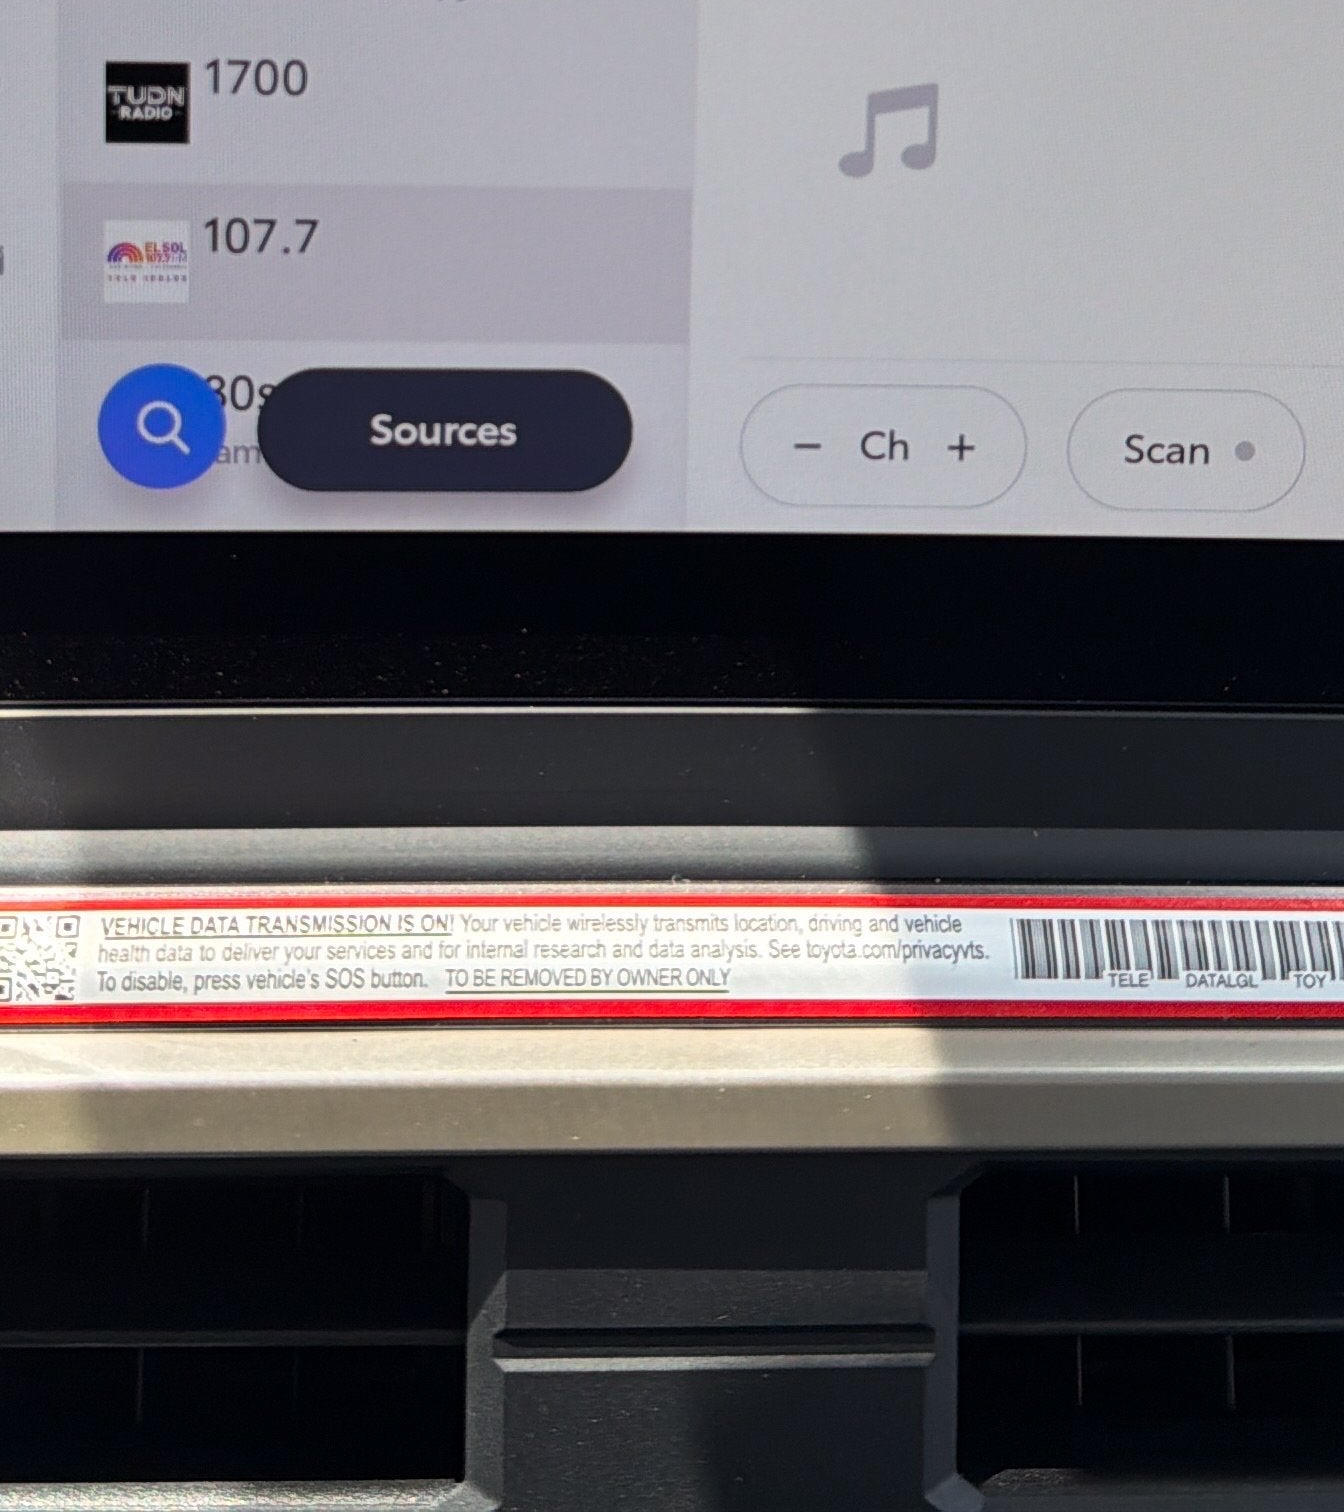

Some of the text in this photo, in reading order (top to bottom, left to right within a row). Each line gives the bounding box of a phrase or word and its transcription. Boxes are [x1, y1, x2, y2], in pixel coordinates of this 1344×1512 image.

[205, 59, 309, 96] 1700
[108, 85, 185, 107] TUDN
[119, 105, 174, 121] RADIO
[204, 216, 320, 254] 107.7
[368, 413, 518, 447] Sources
[860, 429, 910, 461] Ch
[1124, 434, 1211, 466] Scan
[101, 914, 455, 936] VEHICLE DATA TRANSMISSION IS ON!
[460, 913, 962, 937] Your vehicle wirelessly transmits location, driving and vehicle
[98, 943, 150, 963] health
[156, 943, 193, 962] data
[200, 944, 216, 962] to
[222, 943, 279, 961] deliver
[284, 945, 322, 966] your
[327, 941, 396, 960] services
[402, 941, 433, 960] and
[438, 940, 461, 959] for
[467, 940, 528, 959] internal
[534, 940, 606, 959] research
[612, 939, 643, 958] and
[648, 939, 685, 958] data
[690, 938, 763, 963] analysis.
[768, 938, 801, 958] See
[97, 970, 117, 991] To
[121, 970, 188, 993] disable,
[194, 974, 241, 995] press
[325, 968, 365, 989] SOS
[371, 968, 429, 988] button.
[444, 968, 469, 987] TO
[473, 968, 496, 987] BE
[501, 968, 587, 987] REMOVED
[590, 968, 613, 987] BY
[617, 967, 682, 986] OWNER
[686, 967, 731, 986] ONLY
[1108, 972, 1327, 988] TELE DATALGL TOY
